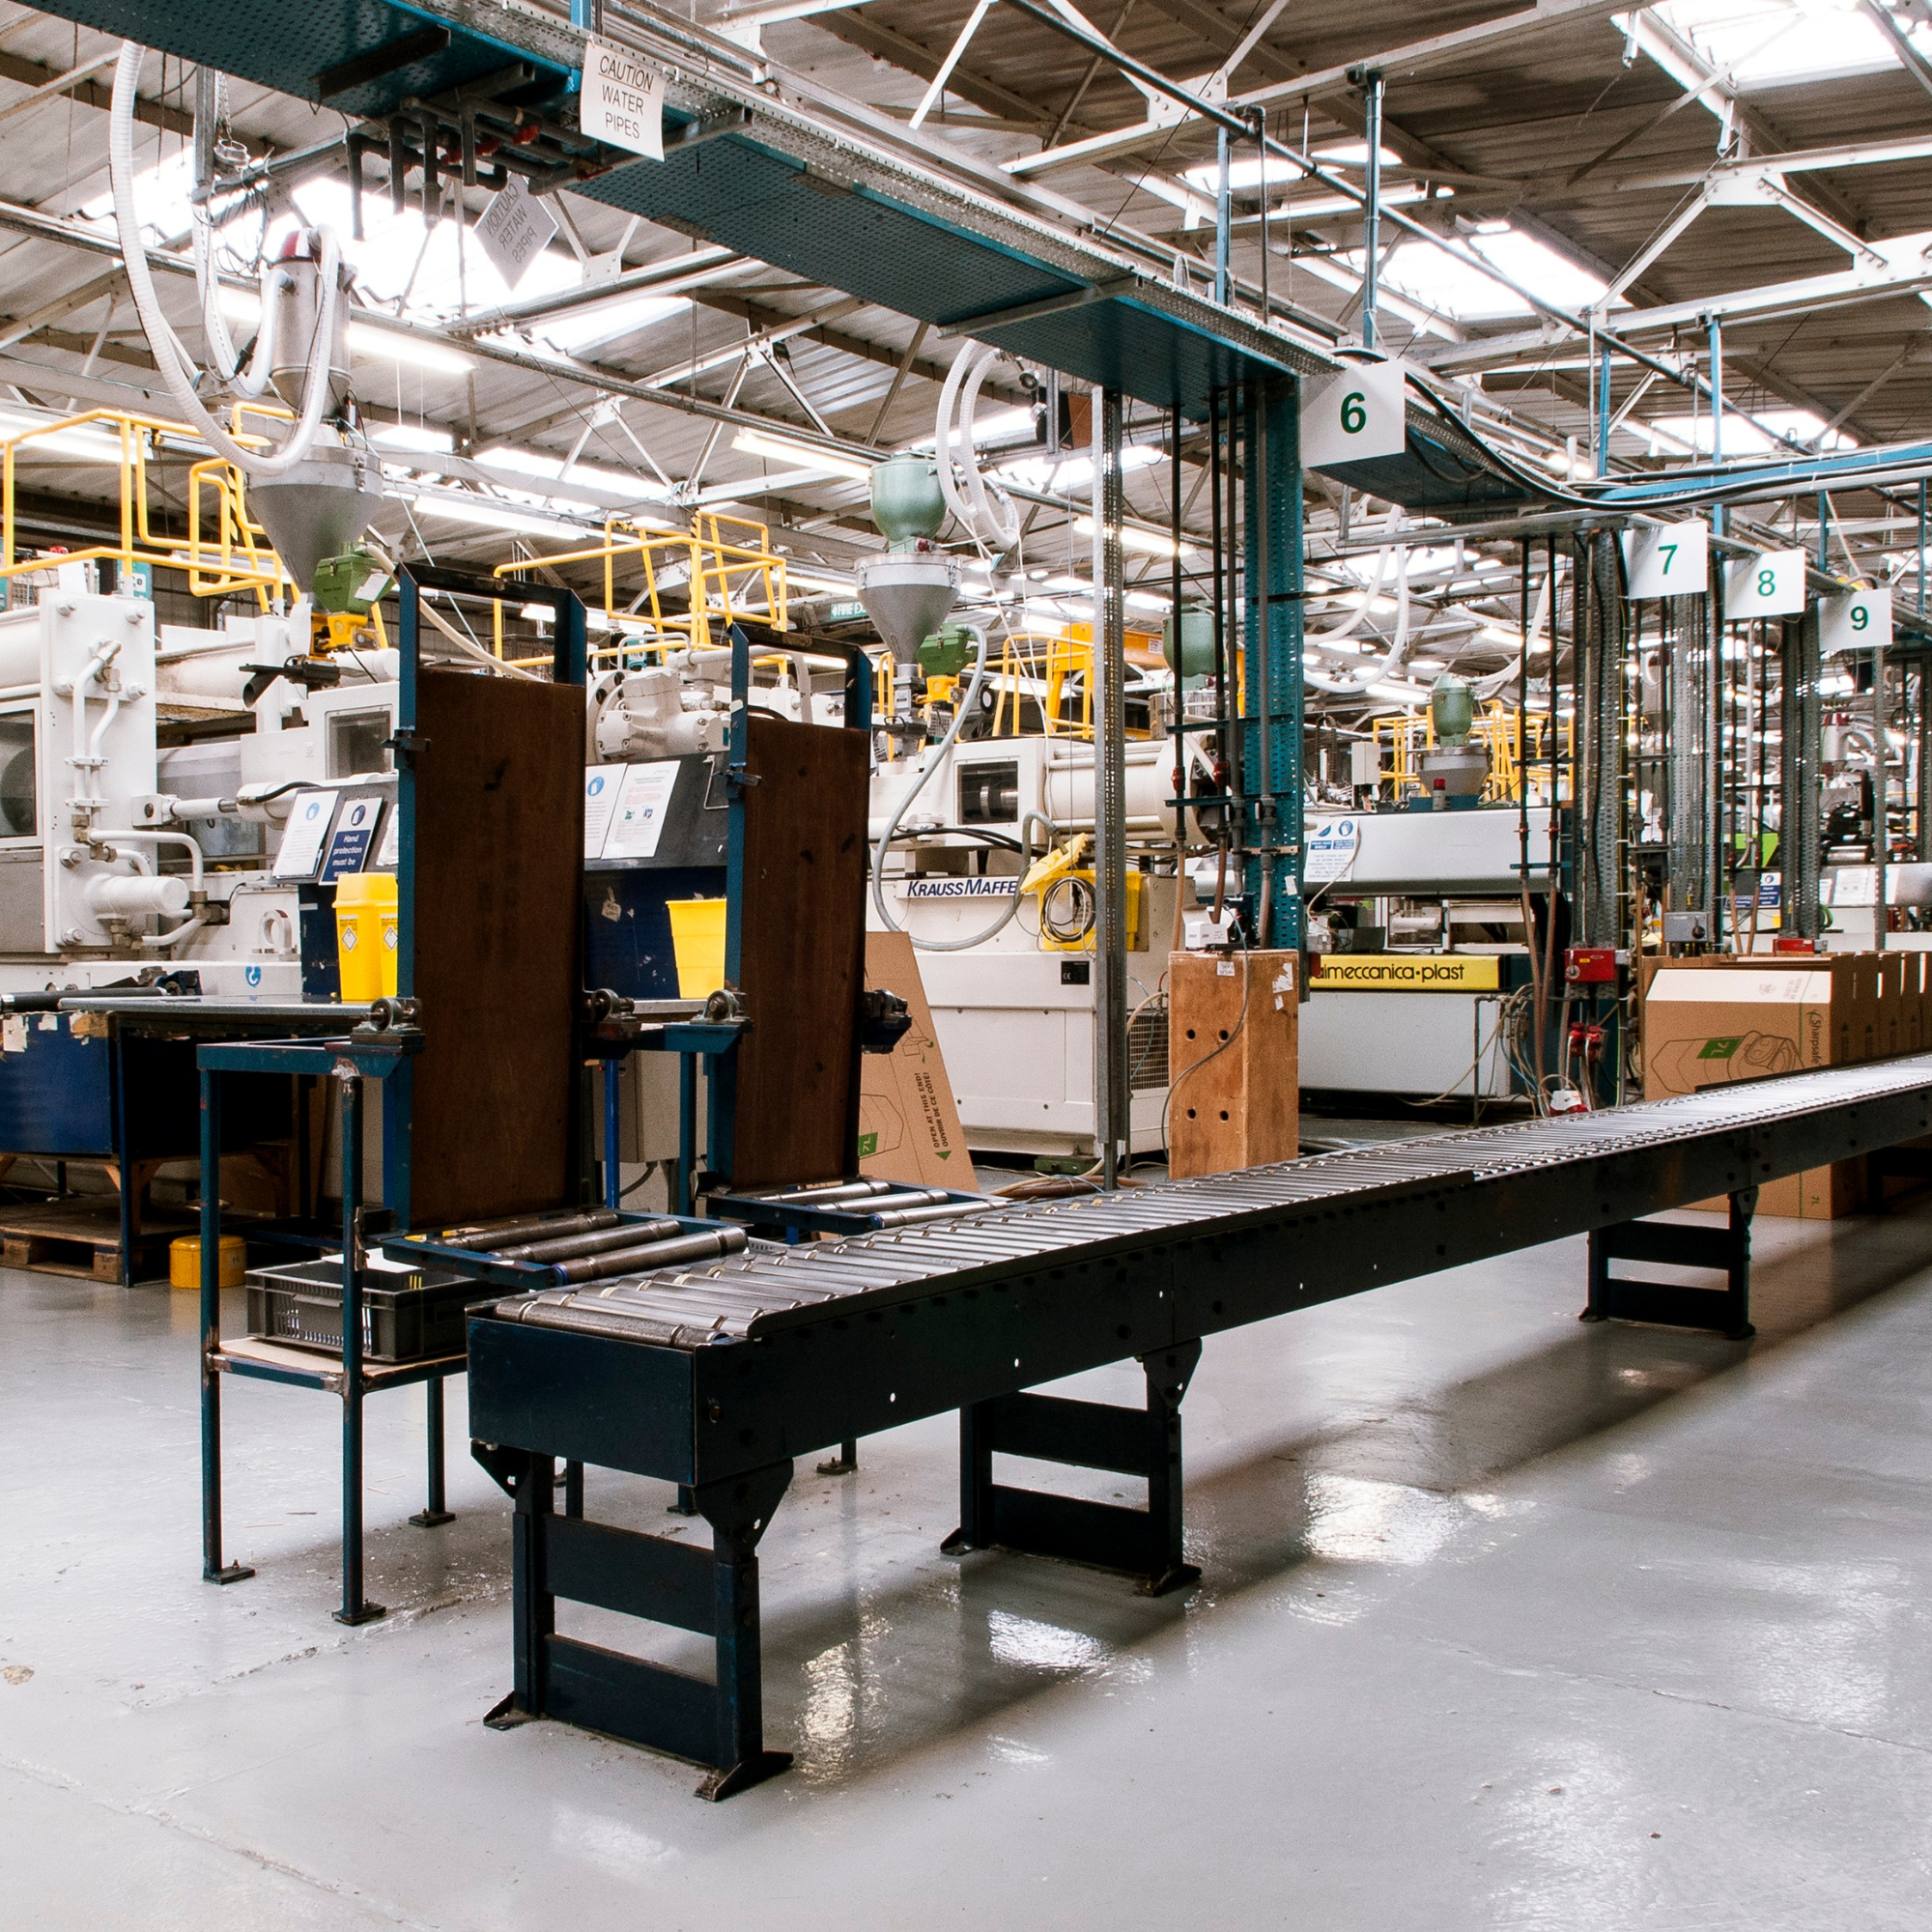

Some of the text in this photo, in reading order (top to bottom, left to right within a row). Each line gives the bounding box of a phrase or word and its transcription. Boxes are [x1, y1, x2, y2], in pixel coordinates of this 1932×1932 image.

[599, 55, 654, 91] CAUTION
[602, 83, 644, 116] WATER
[605, 111, 640, 139] PIPES
[1340, 391, 1367, 435] 6
[1657, 544, 1679, 576] 7
[1757, 569, 1776, 597] 8
[1849, 605, 1869, 631] 9
[343, 834, 360, 843] Hand
[332, 845, 363, 856] protection
[331, 857, 356, 867] must be
[907, 878, 1018, 896] KRAUSSMAFFE
[1710, 1041, 1730, 1055] 7L
[1810, 1019, 1822, 1065] Sharpsafe
[914, 1072, 924, 1092] END!
[920, 1094, 930, 1112] THIS
[929, 1094, 937, 1106] CE
[933, 1107, 941, 1118] DE
[929, 1126, 940, 1148] OPEN
[936, 1119, 949, 1147] OUVRIR
[862, 1136, 871, 1153] 7L
